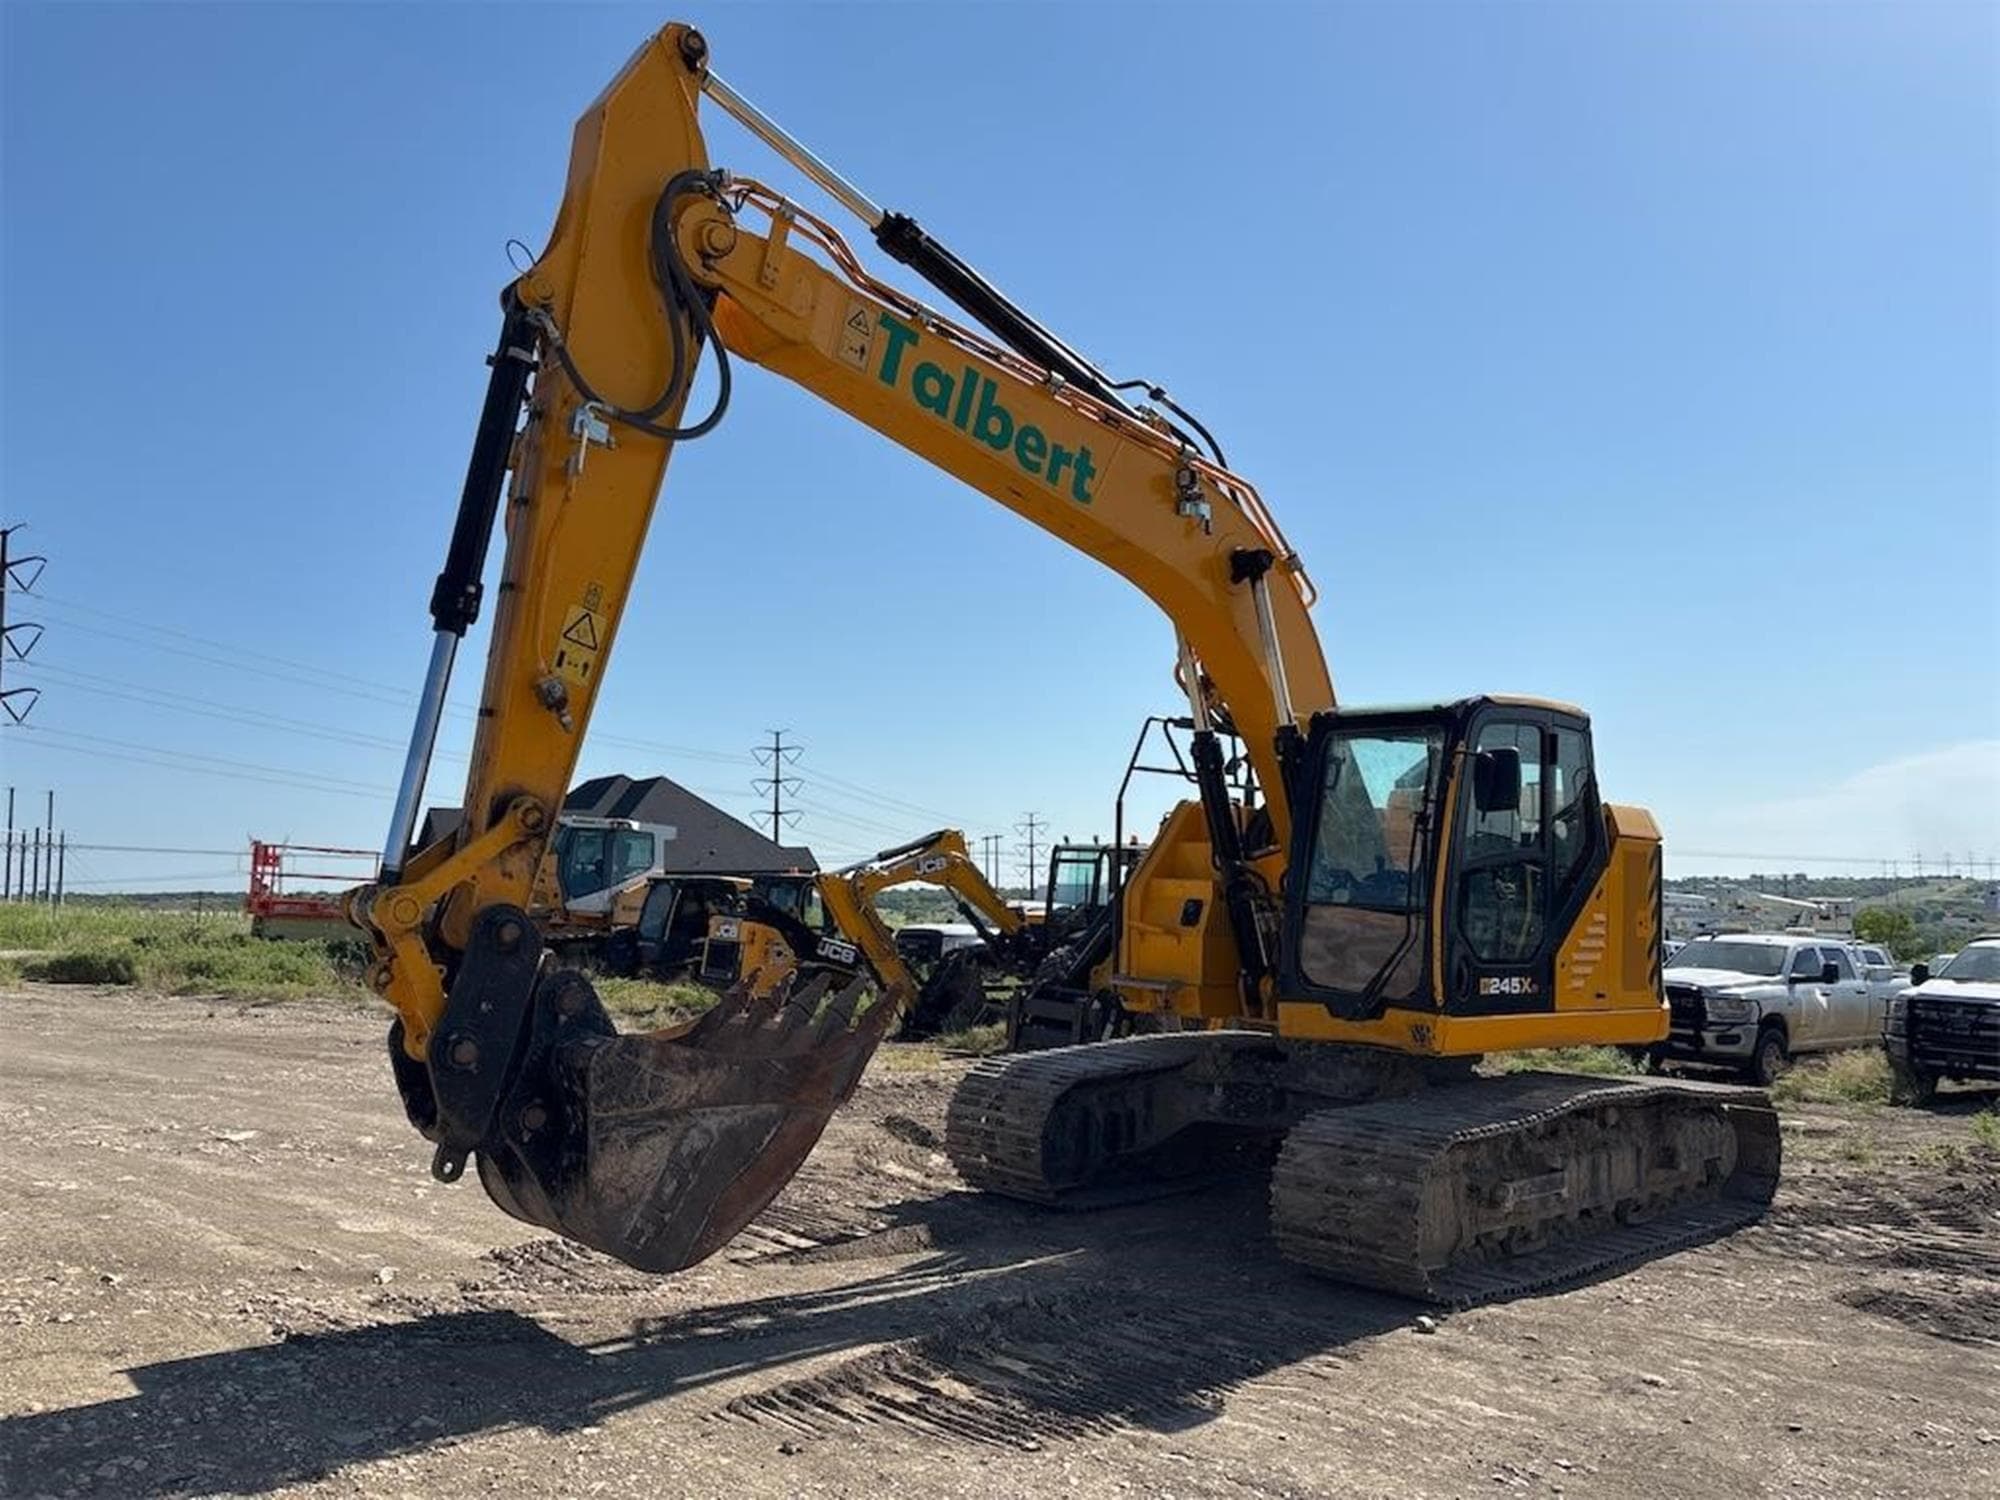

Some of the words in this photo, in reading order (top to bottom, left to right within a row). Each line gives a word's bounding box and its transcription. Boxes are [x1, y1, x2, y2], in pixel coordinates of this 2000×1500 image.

[878, 311, 1097, 505] Talbert
[914, 856, 946, 875] JCB
[816, 941, 856, 964] JCB
